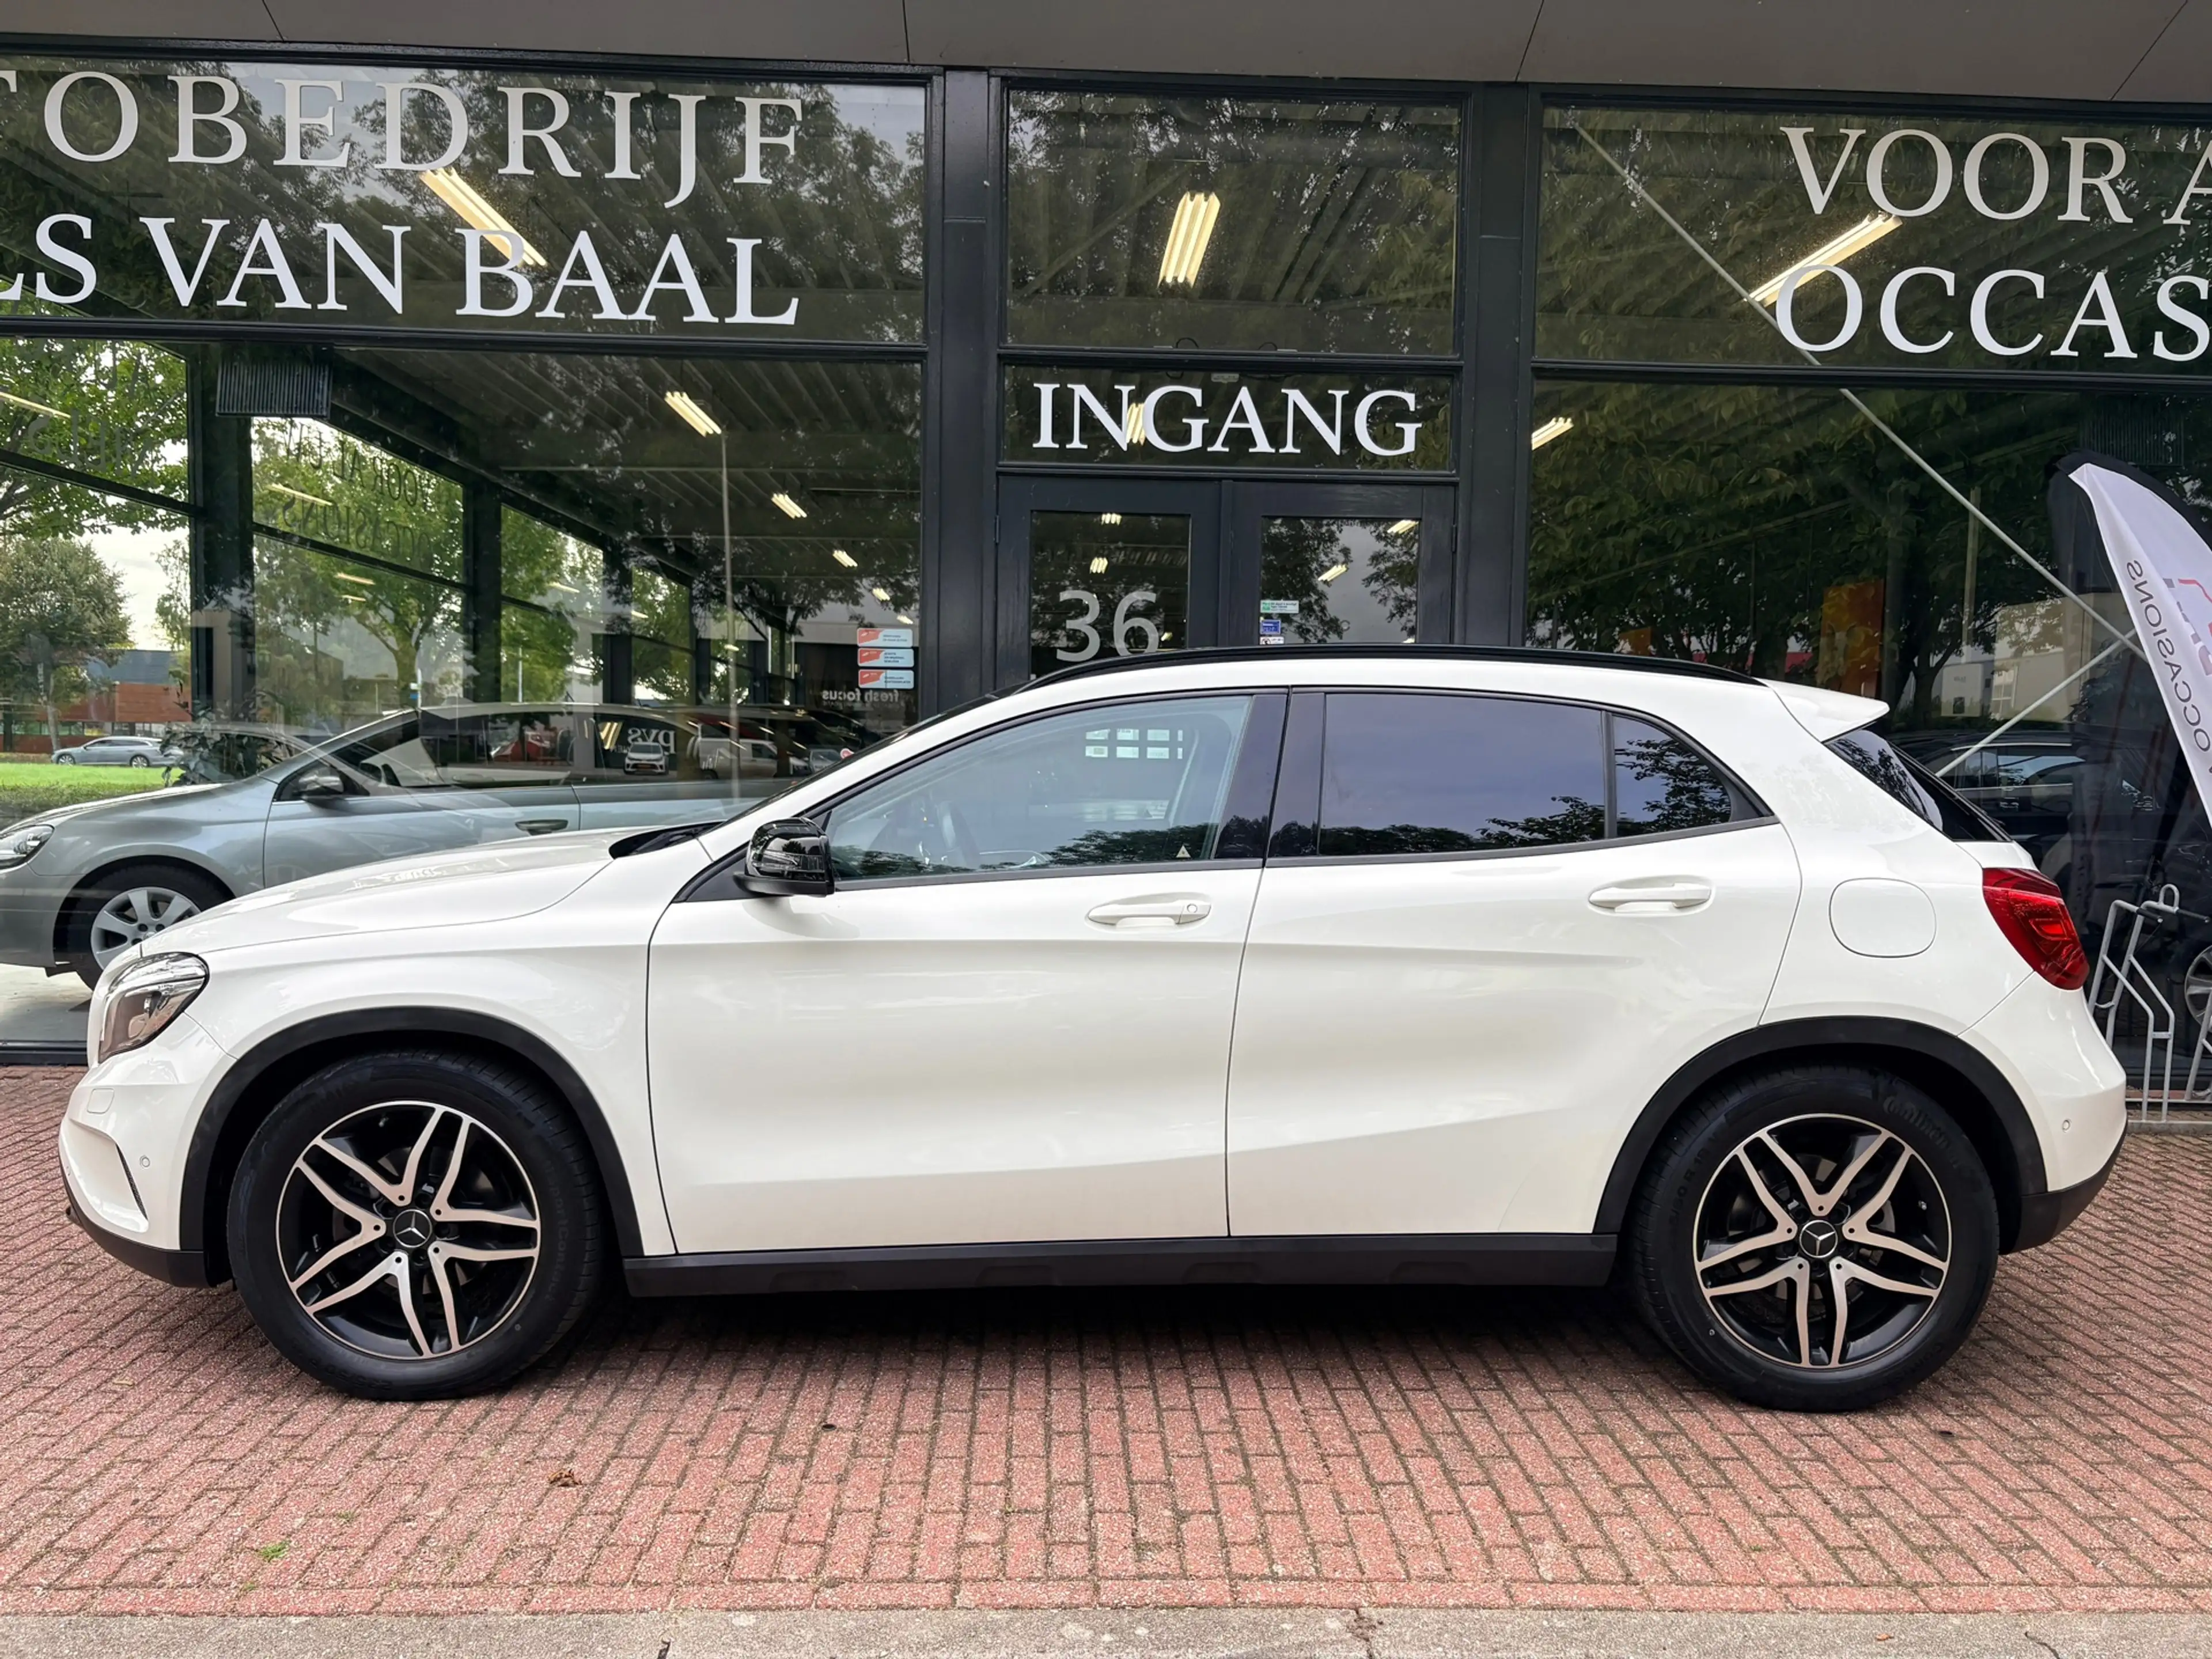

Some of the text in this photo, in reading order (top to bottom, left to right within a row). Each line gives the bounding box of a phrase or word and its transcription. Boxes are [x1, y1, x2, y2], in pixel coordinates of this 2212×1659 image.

[1779, 126, 2134, 224] VOOR
[139, 217, 411, 315] VAN
[454, 229, 800, 325] BAAL
[1775, 264, 2212, 362] OCCAS
[1033, 382, 1423, 457] INGANG
[1056, 589, 1160, 662] 36
